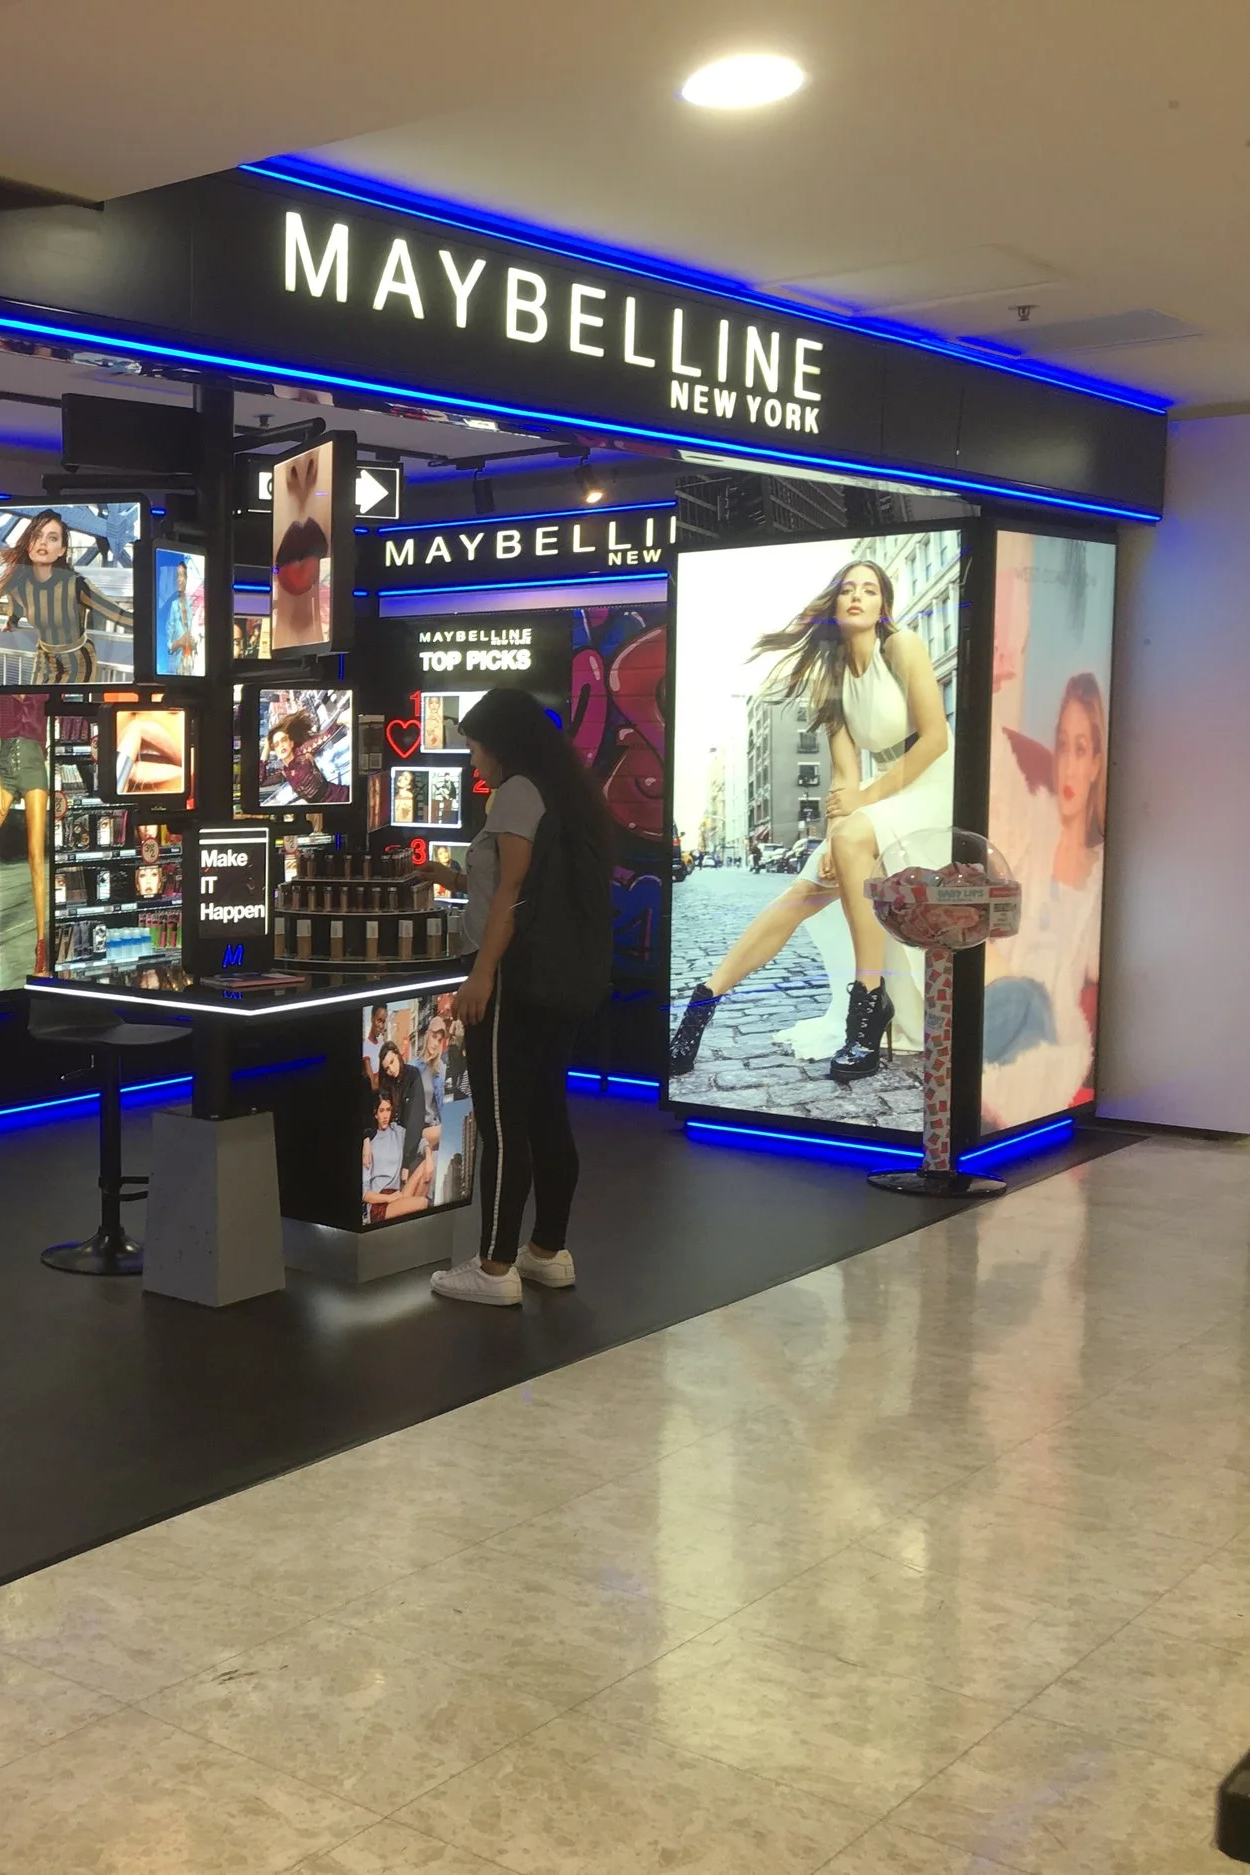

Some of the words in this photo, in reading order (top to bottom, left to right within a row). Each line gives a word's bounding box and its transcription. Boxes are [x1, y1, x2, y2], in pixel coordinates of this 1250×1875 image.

[285, 211, 823, 402] MAYBELLINE
[670, 379, 737, 420] NEW
[746, 393, 820, 435] YORK
[607, 548, 662, 567] NEW
[418, 628, 533, 643] MAYBELLINE
[418, 650, 463, 672] TOP
[465, 648, 532, 671] PICKS
[409, 690, 422, 717] 1
[200, 849, 248, 868] Make
[410, 838, 428, 865] 3
[200, 876, 218, 895] IT
[200, 902, 266, 924] Happen
